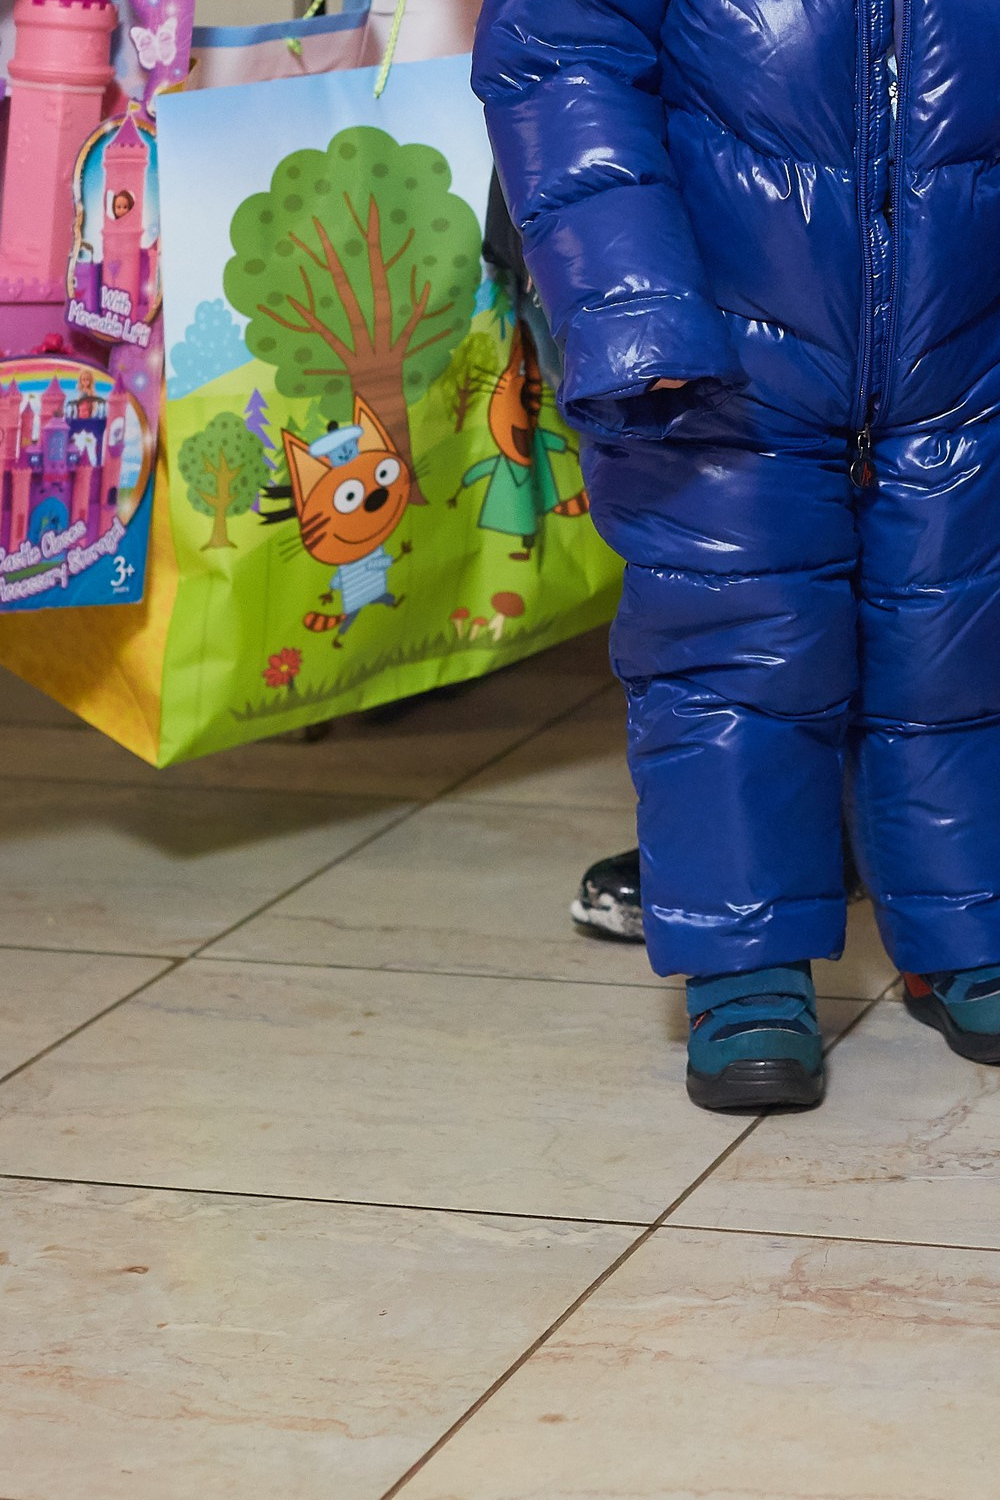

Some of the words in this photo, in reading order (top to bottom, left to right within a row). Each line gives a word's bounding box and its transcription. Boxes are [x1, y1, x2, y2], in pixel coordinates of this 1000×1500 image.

[101, 285, 132, 316] With
[0, 541, 41, 572] astle
[110, 555, 136, 587] 3+
